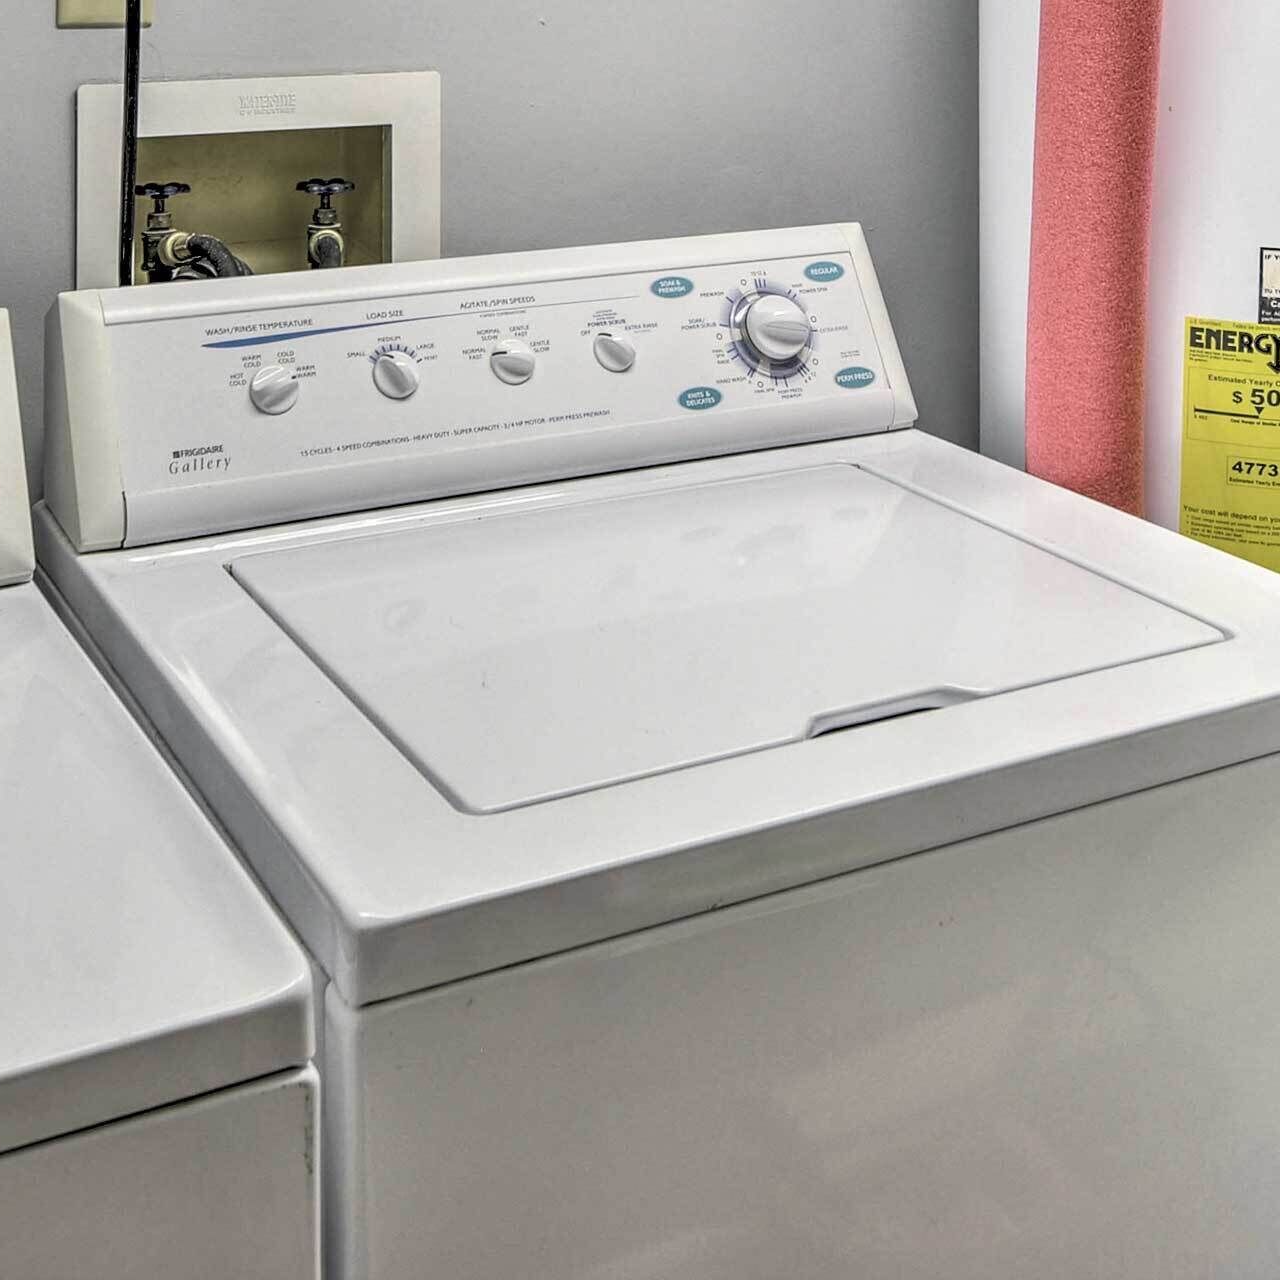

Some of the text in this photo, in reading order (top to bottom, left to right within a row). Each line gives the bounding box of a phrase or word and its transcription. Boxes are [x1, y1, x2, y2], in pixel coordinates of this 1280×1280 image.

[509, 295, 536, 305] SPEEDS
[366, 310, 404, 320] LOAD SIZE
[205, 318, 314, 337] WASH/RINSE TEMPERATURE
[476, 328, 500, 336] NORMAL
[509, 324, 530, 333] GENTLE
[481, 334, 499, 342] SLOW
[346, 351, 366, 359] SMALL
[243, 361, 262, 369] COLD
[230, 372, 245, 380] HOT
[1208, 373, 1247, 385] Estimated
[1248, 379, 1273, 388] Yearly
[229, 378, 247, 387] COLD
[685, 397, 716, 407] DELICATES
[1232, 391, 1243, 404] $
[524, 417, 546, 426] MOTOR
[453, 423, 501, 437] SUPER CAPACITY
[413, 430, 450, 442] HEAVY DUTY
[341, 442, 362, 452] SPEED
[362, 436, 410, 449] COMBINATIONS
[309, 446, 333, 456] CYCLES
[169, 457, 231, 475] Gallery
[1231, 460, 1279, 478] 4773
[1229, 476, 1255, 485] Estimated
[1255, 479, 1271, 487] Yearly
[1183, 505, 1200, 514] Your
[1201, 508, 1216, 516] cost
[1217, 510, 1229, 518] will
[1230, 511, 1258, 522] depend
